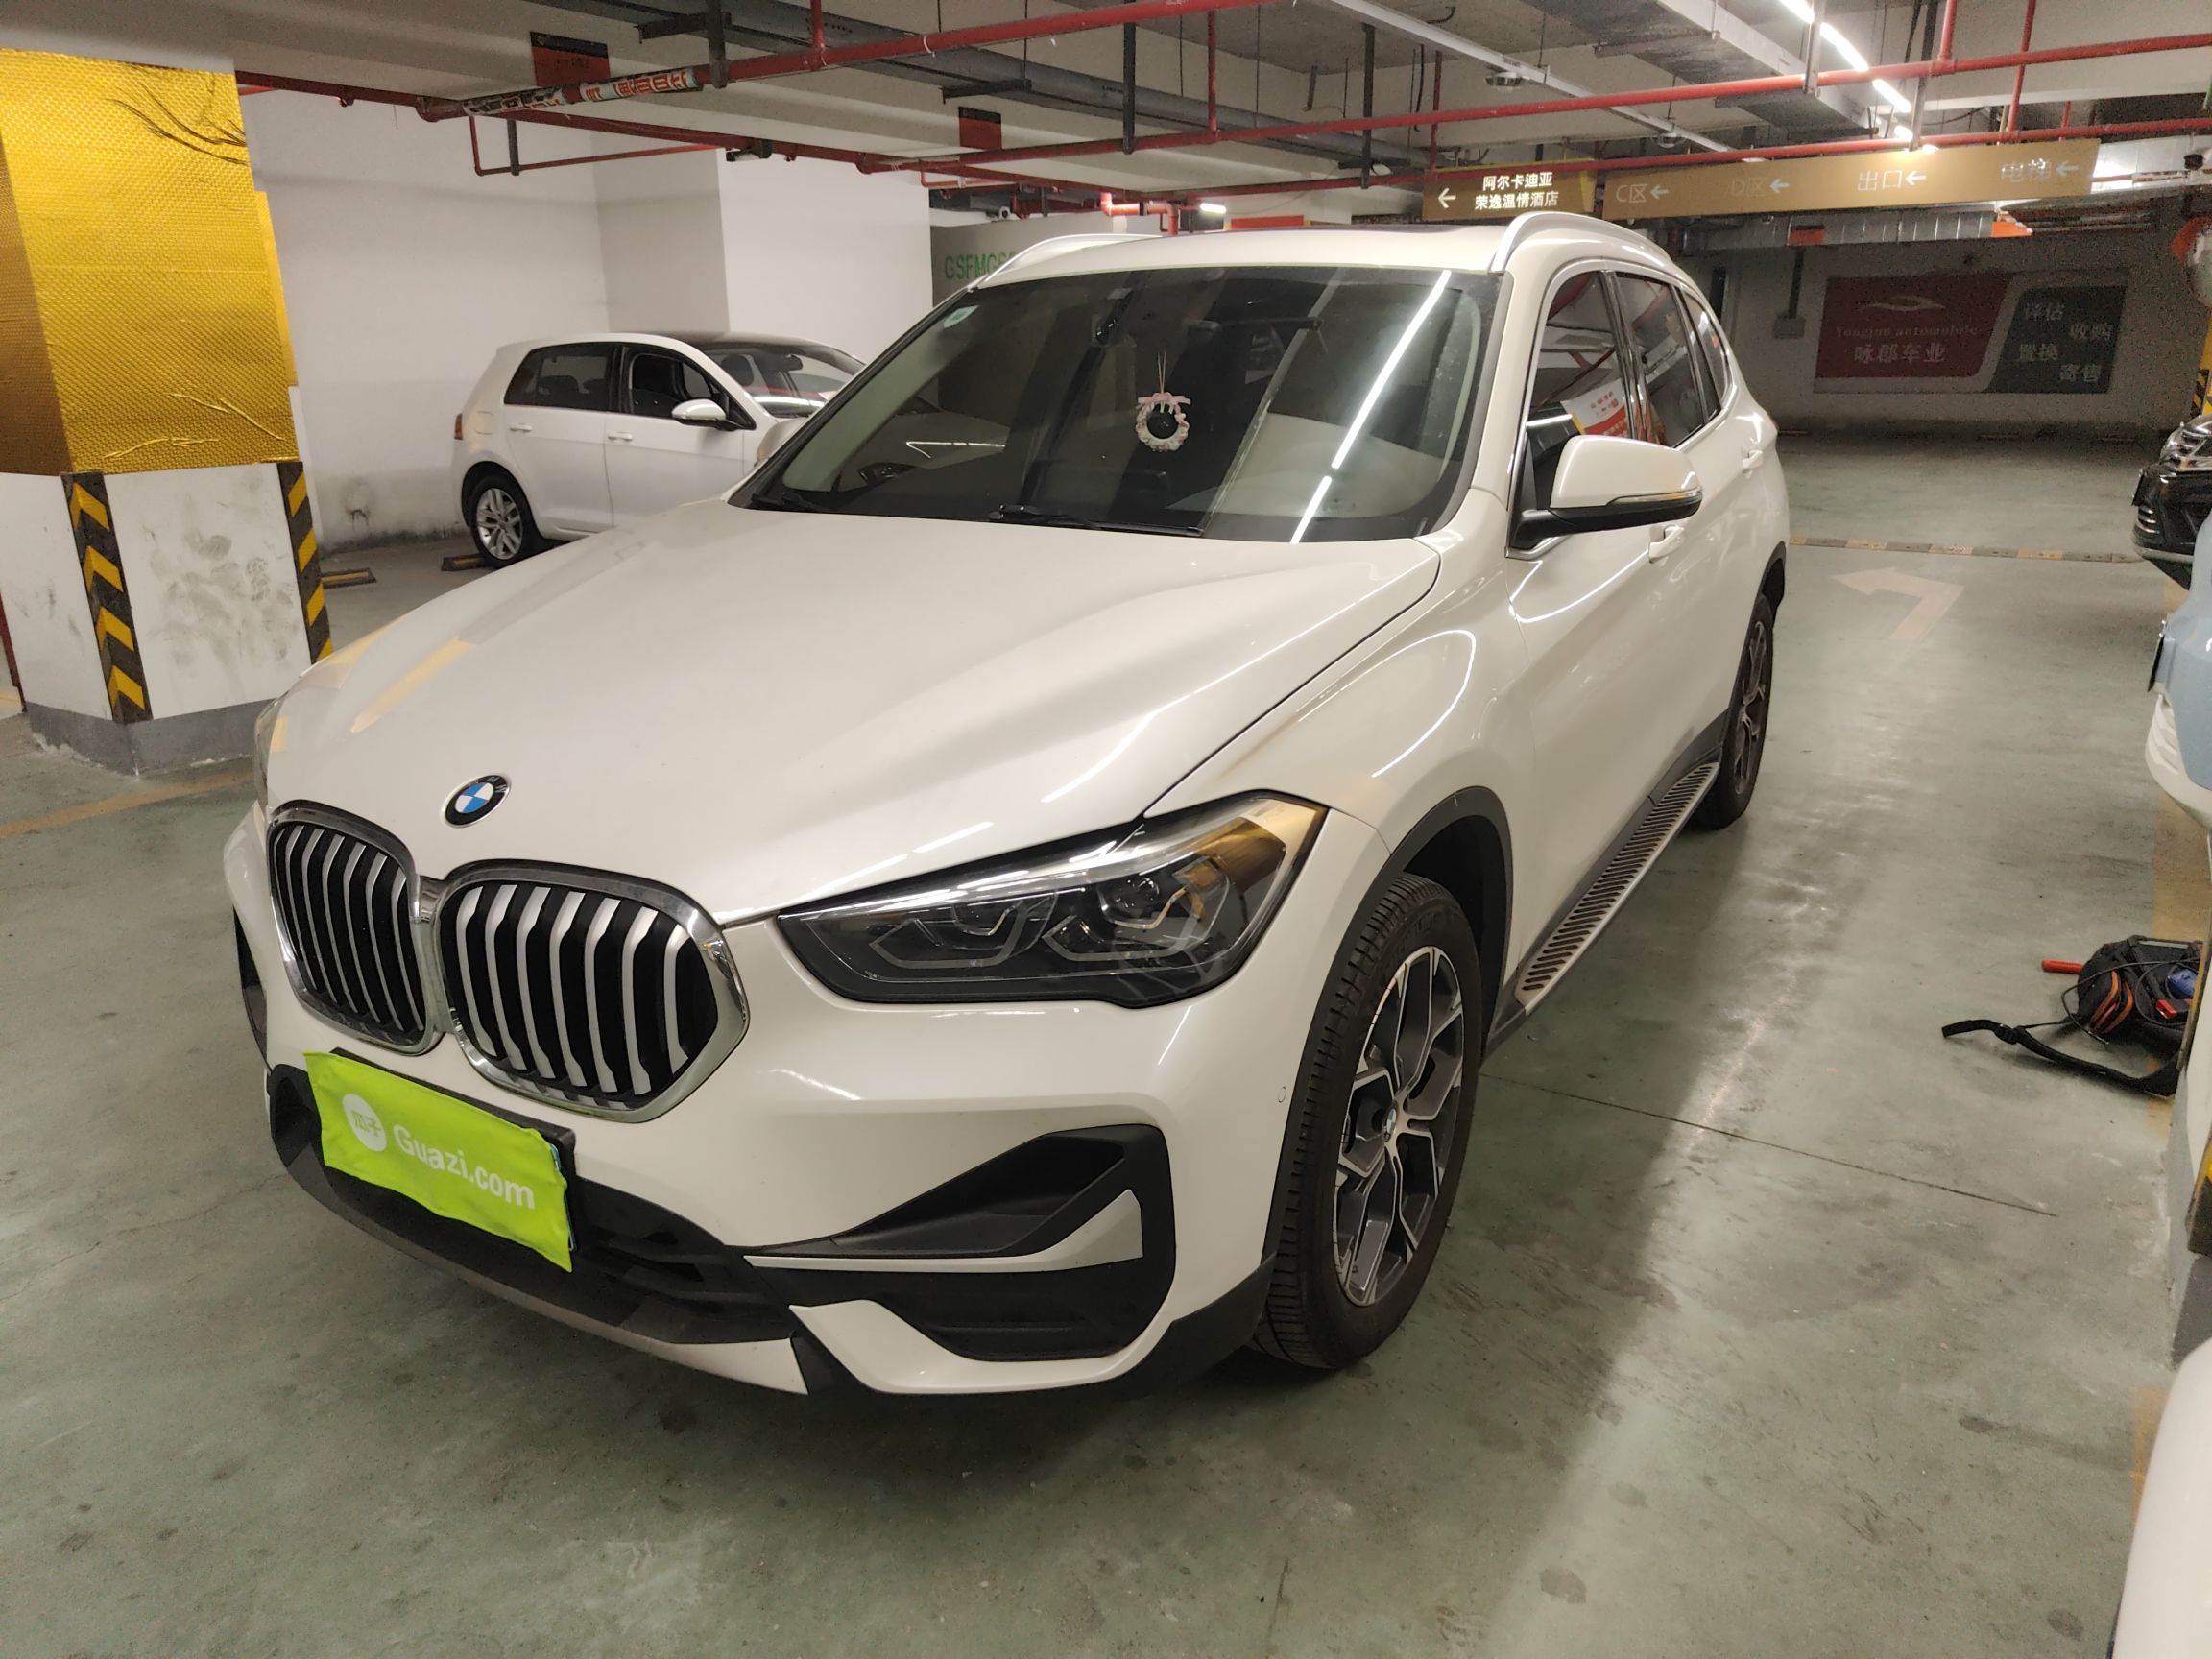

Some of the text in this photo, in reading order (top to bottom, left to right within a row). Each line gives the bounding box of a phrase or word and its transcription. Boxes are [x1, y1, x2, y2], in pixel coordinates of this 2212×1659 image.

[1482, 171, 1553, 191] 阿尔卡迪亚
[1858, 169, 1904, 192] 出口
[1475, 190, 1559, 211] 荣逸温情酒店
[1615, 183, 1648, 204] C区
[393, 1123, 536, 1210] Guazi.com
